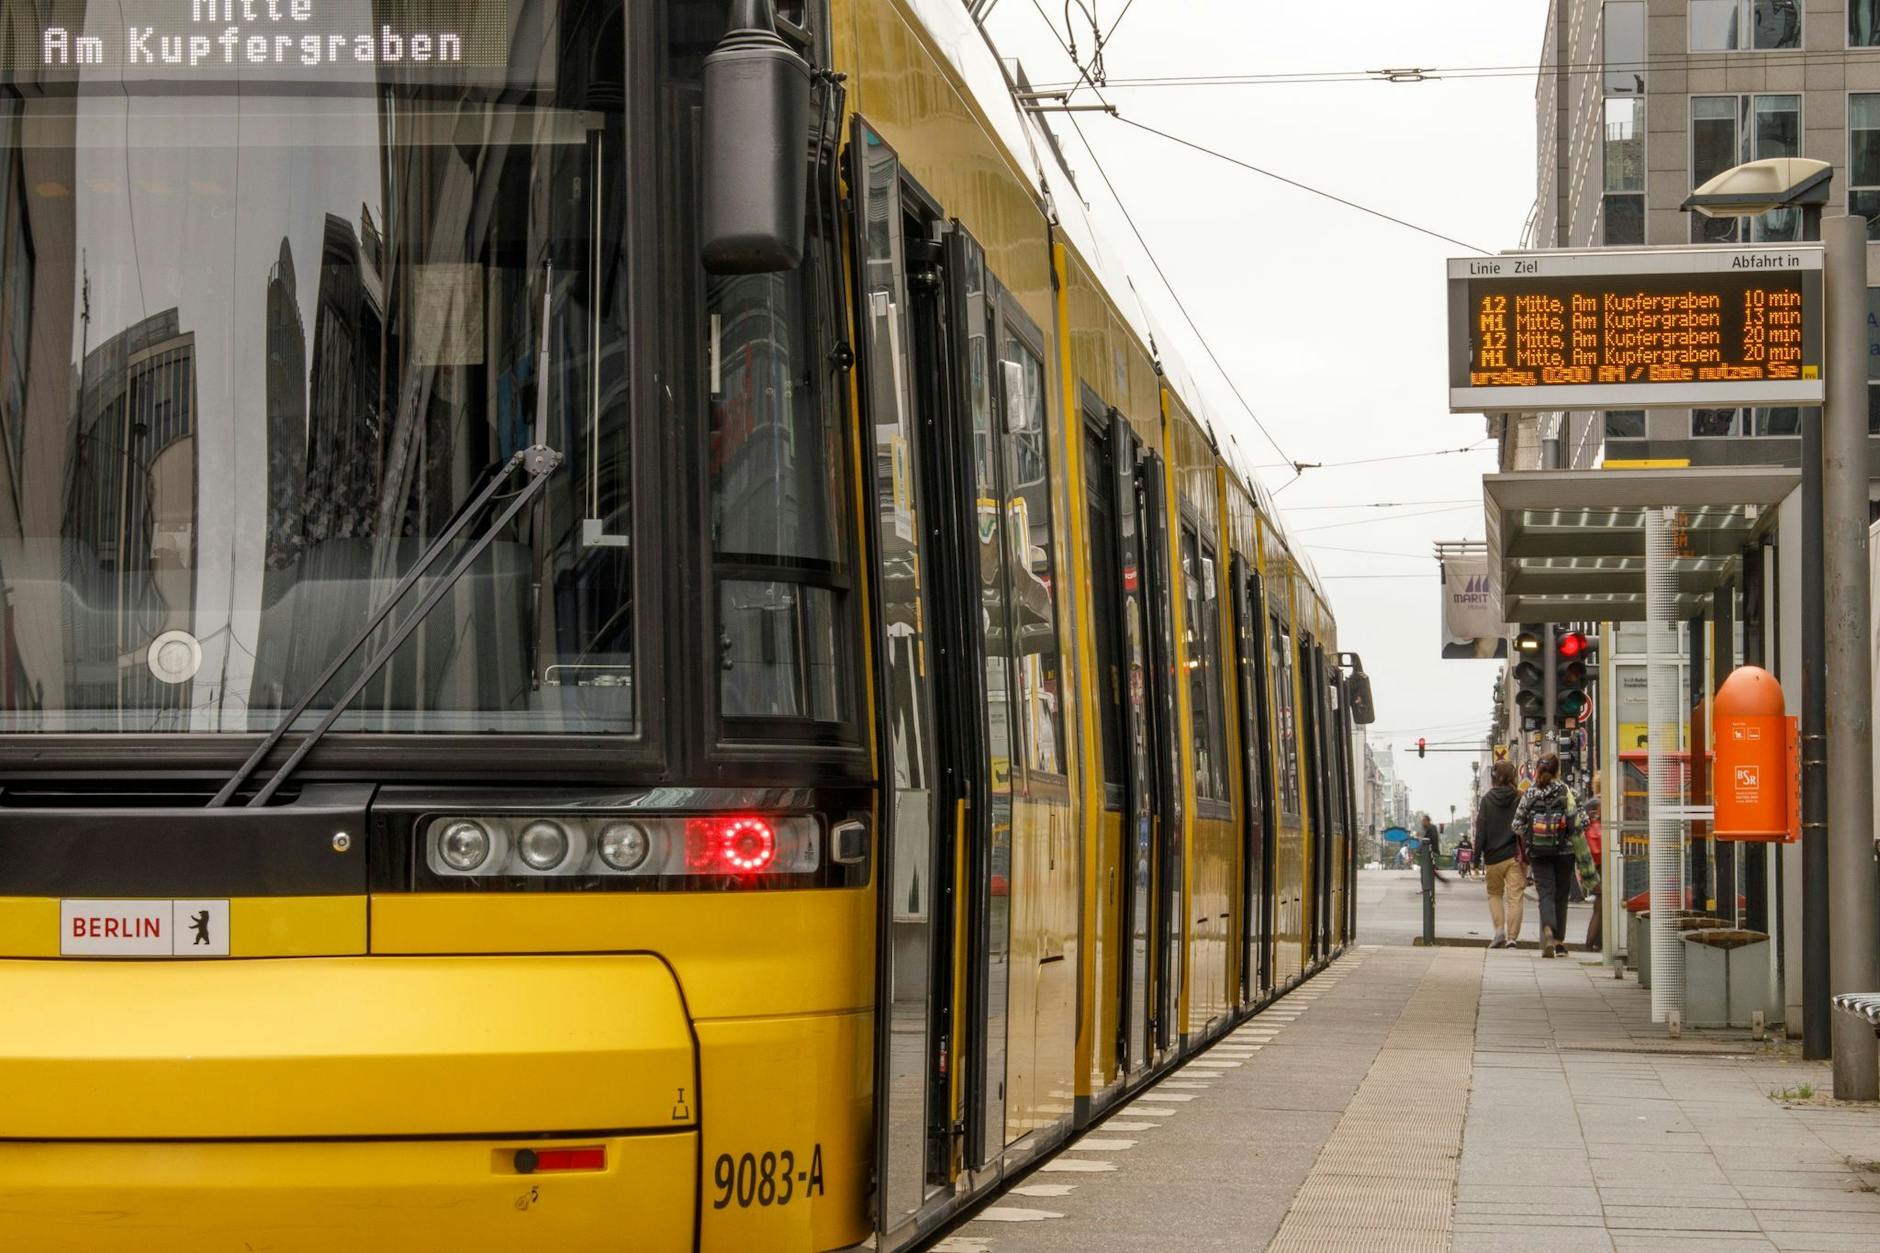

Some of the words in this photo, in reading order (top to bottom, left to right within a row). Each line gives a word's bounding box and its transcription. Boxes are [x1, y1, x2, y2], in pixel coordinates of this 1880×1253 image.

[44, 28, 102, 63] Am
[130, 26, 462, 65] Kupfergraben
[1470, 262, 1501, 275] Linie
[1514, 261, 1538, 274] Ziel
[1732, 255, 1783, 269] Abfahrt
[1788, 254, 1800, 267] in
[1482, 297, 1506, 313] 12
[1516, 295, 1564, 313] Mitte,
[1572, 293, 1597, 311] Am
[1605, 292, 1720, 312] Kupfergraben
[1745, 290, 1764, 307] 10
[1769, 289, 1801, 306] min
[1481, 314, 1506, 331] M1
[1516, 313, 1564, 331] Mitte,
[1572, 311, 1597, 329] Am
[1605, 310, 1720, 330] Kupfergraben
[1745, 308, 1764, 325] 13
[1769, 307, 1801, 324] min
[1482, 332, 1506, 348] 12
[1516, 331, 1564, 349] Mitte,
[1572, 329, 1597, 347] Am
[1605, 328, 1720, 348] Kupfergraben
[1744, 326, 1764, 343] 20
[1769, 325, 1801, 342] min
[1481, 350, 1507, 366] M1
[1516, 349, 1564, 367] Mitte,
[1572, 347, 1597, 365] Am
[1605, 346, 1720, 366] Kupfergraben
[1744, 343, 1764, 360] 20
[1769, 343, 1801, 360] min
[1631, 366, 1643, 380] /
[1699, 362, 1763, 380] nutzen
[1737, 769, 1756, 785] BSR
[72, 917, 161, 938] BERLIN
[713, 1143, 825, 1210] 9083-A
